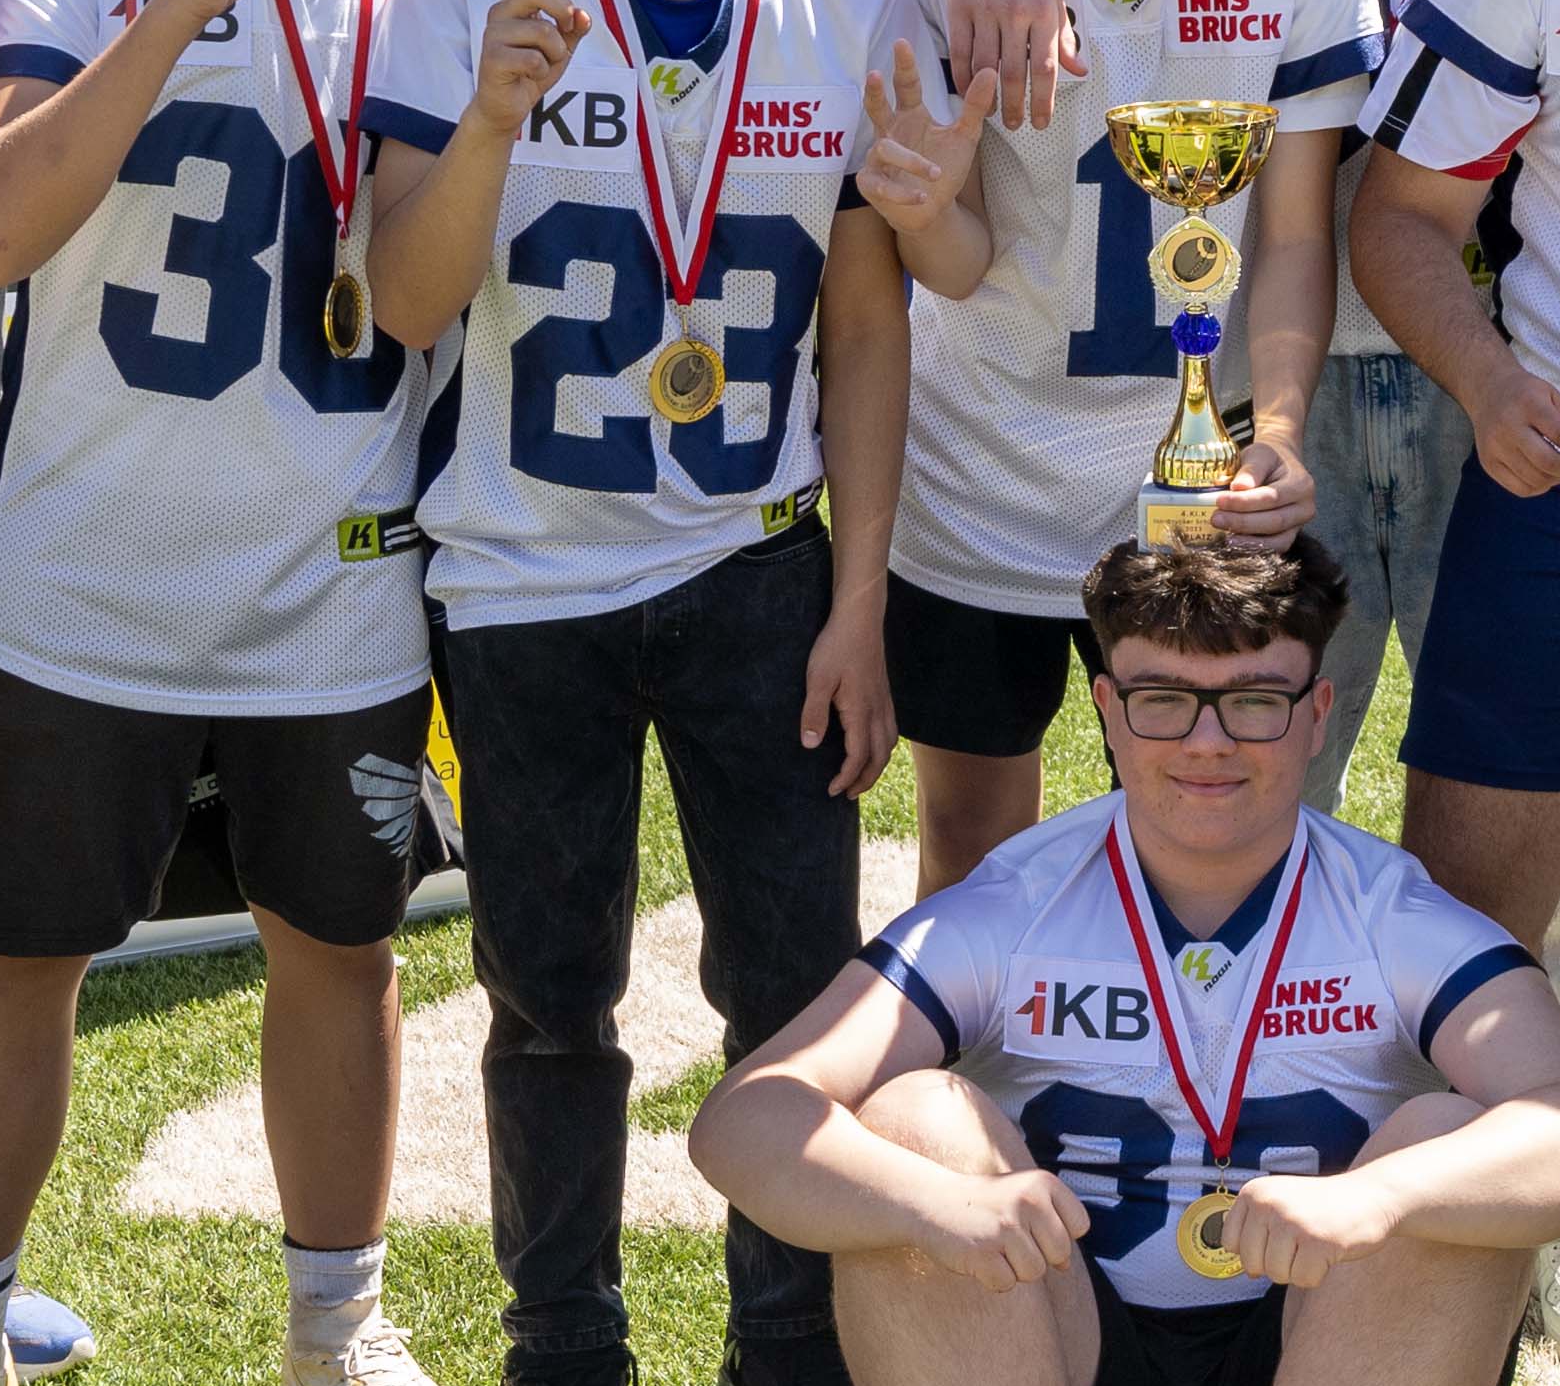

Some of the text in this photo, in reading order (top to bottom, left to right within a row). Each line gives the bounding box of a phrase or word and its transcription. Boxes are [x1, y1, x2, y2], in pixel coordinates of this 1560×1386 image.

[1178, 13, 1283, 43] BRUCK
[731, 131, 846, 158] BRUCK
[99, 99, 407, 413] 30
[508, 199, 826, 496] 23
[1262, 1003, 1379, 1039] BRUCK
